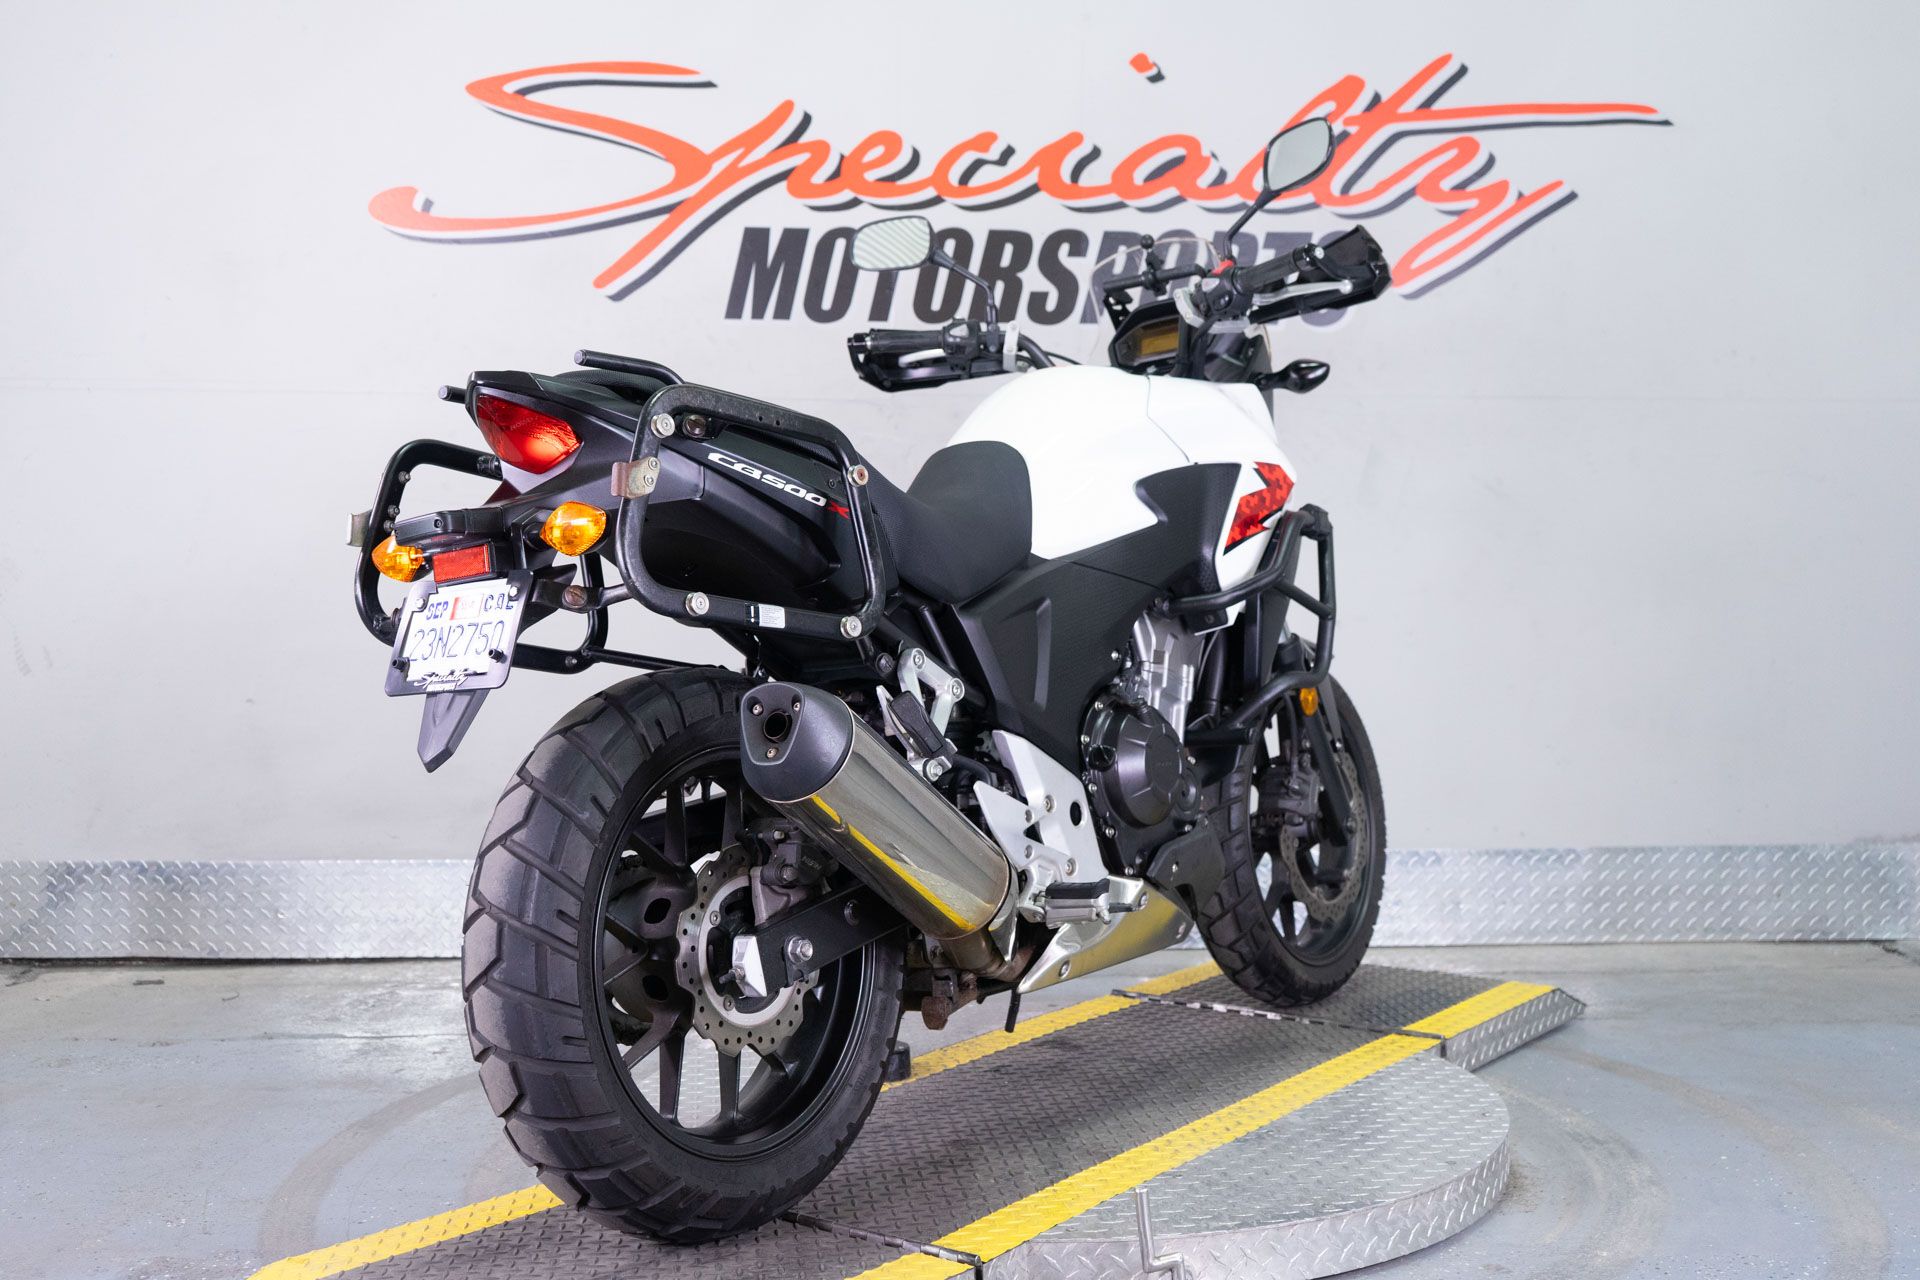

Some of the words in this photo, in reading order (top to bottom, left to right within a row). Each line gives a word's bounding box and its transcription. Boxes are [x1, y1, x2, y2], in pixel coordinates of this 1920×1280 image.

[369, 53, 1672, 298] Specialty
[426, 601, 449, 620] SEP
[408, 620, 504, 661] 23N2750
